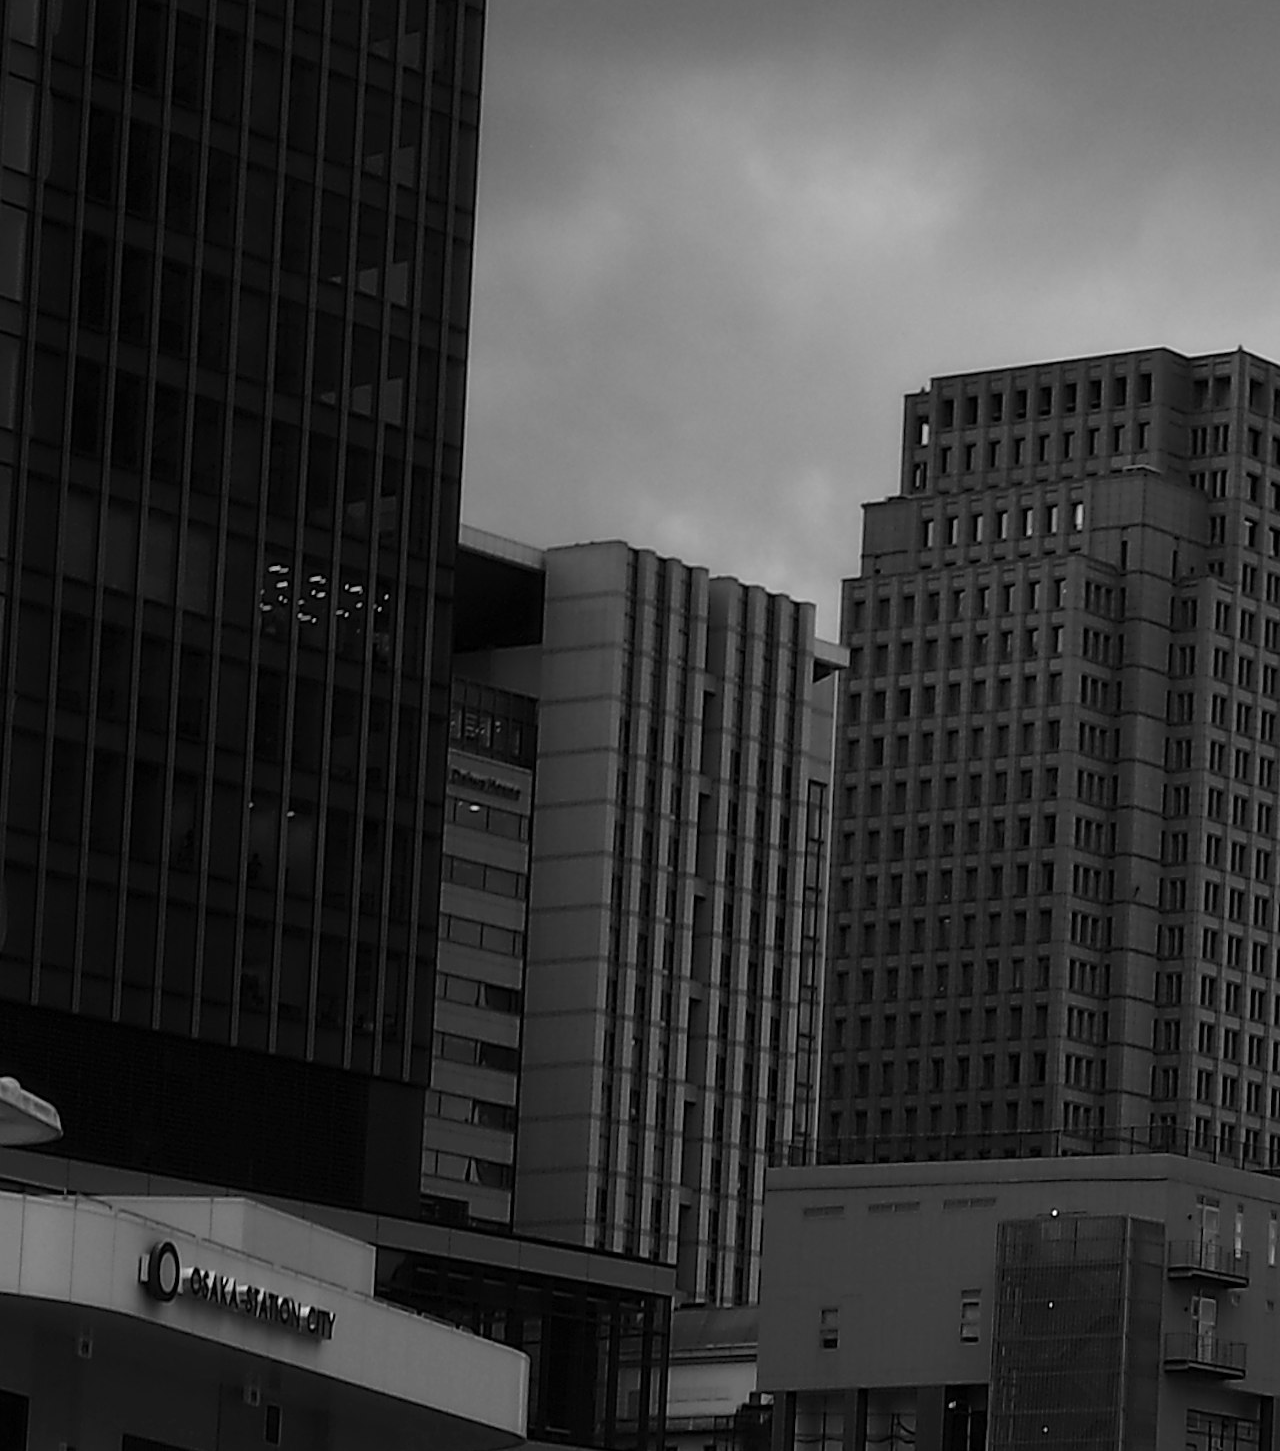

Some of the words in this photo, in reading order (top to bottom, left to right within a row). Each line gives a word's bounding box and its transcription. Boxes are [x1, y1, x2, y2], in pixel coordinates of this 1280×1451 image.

[190, 1267, 239, 1309] OSAKA
[245, 1285, 301, 1329] STATION
[307, 1306, 335, 1340] CITY
